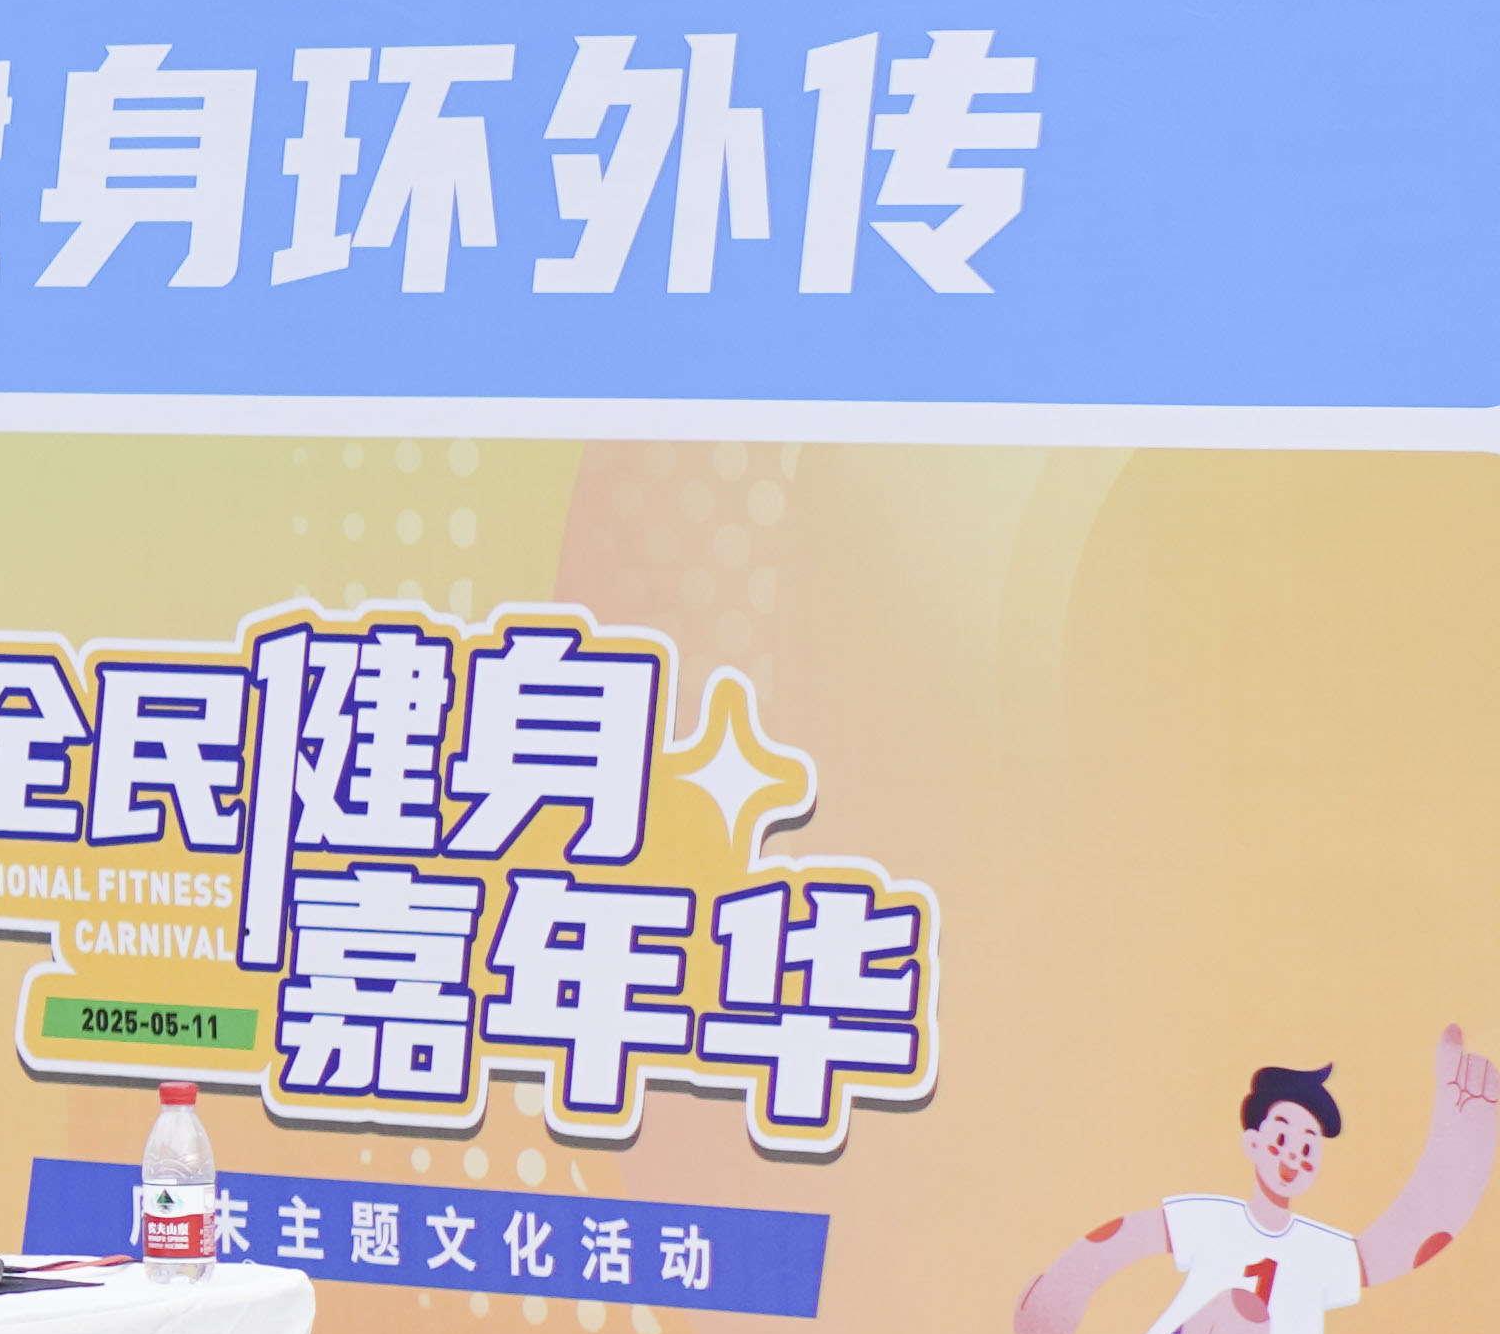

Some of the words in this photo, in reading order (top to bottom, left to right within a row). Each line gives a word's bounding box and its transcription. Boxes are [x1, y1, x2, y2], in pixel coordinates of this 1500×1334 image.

[98, 868, 234, 908] FITNESS
[75, 919, 235, 961] CARNIVAL
[275, 863, 921, 1127] 嘉年华
[81, 1007, 218, 1040] 2025-05-11
